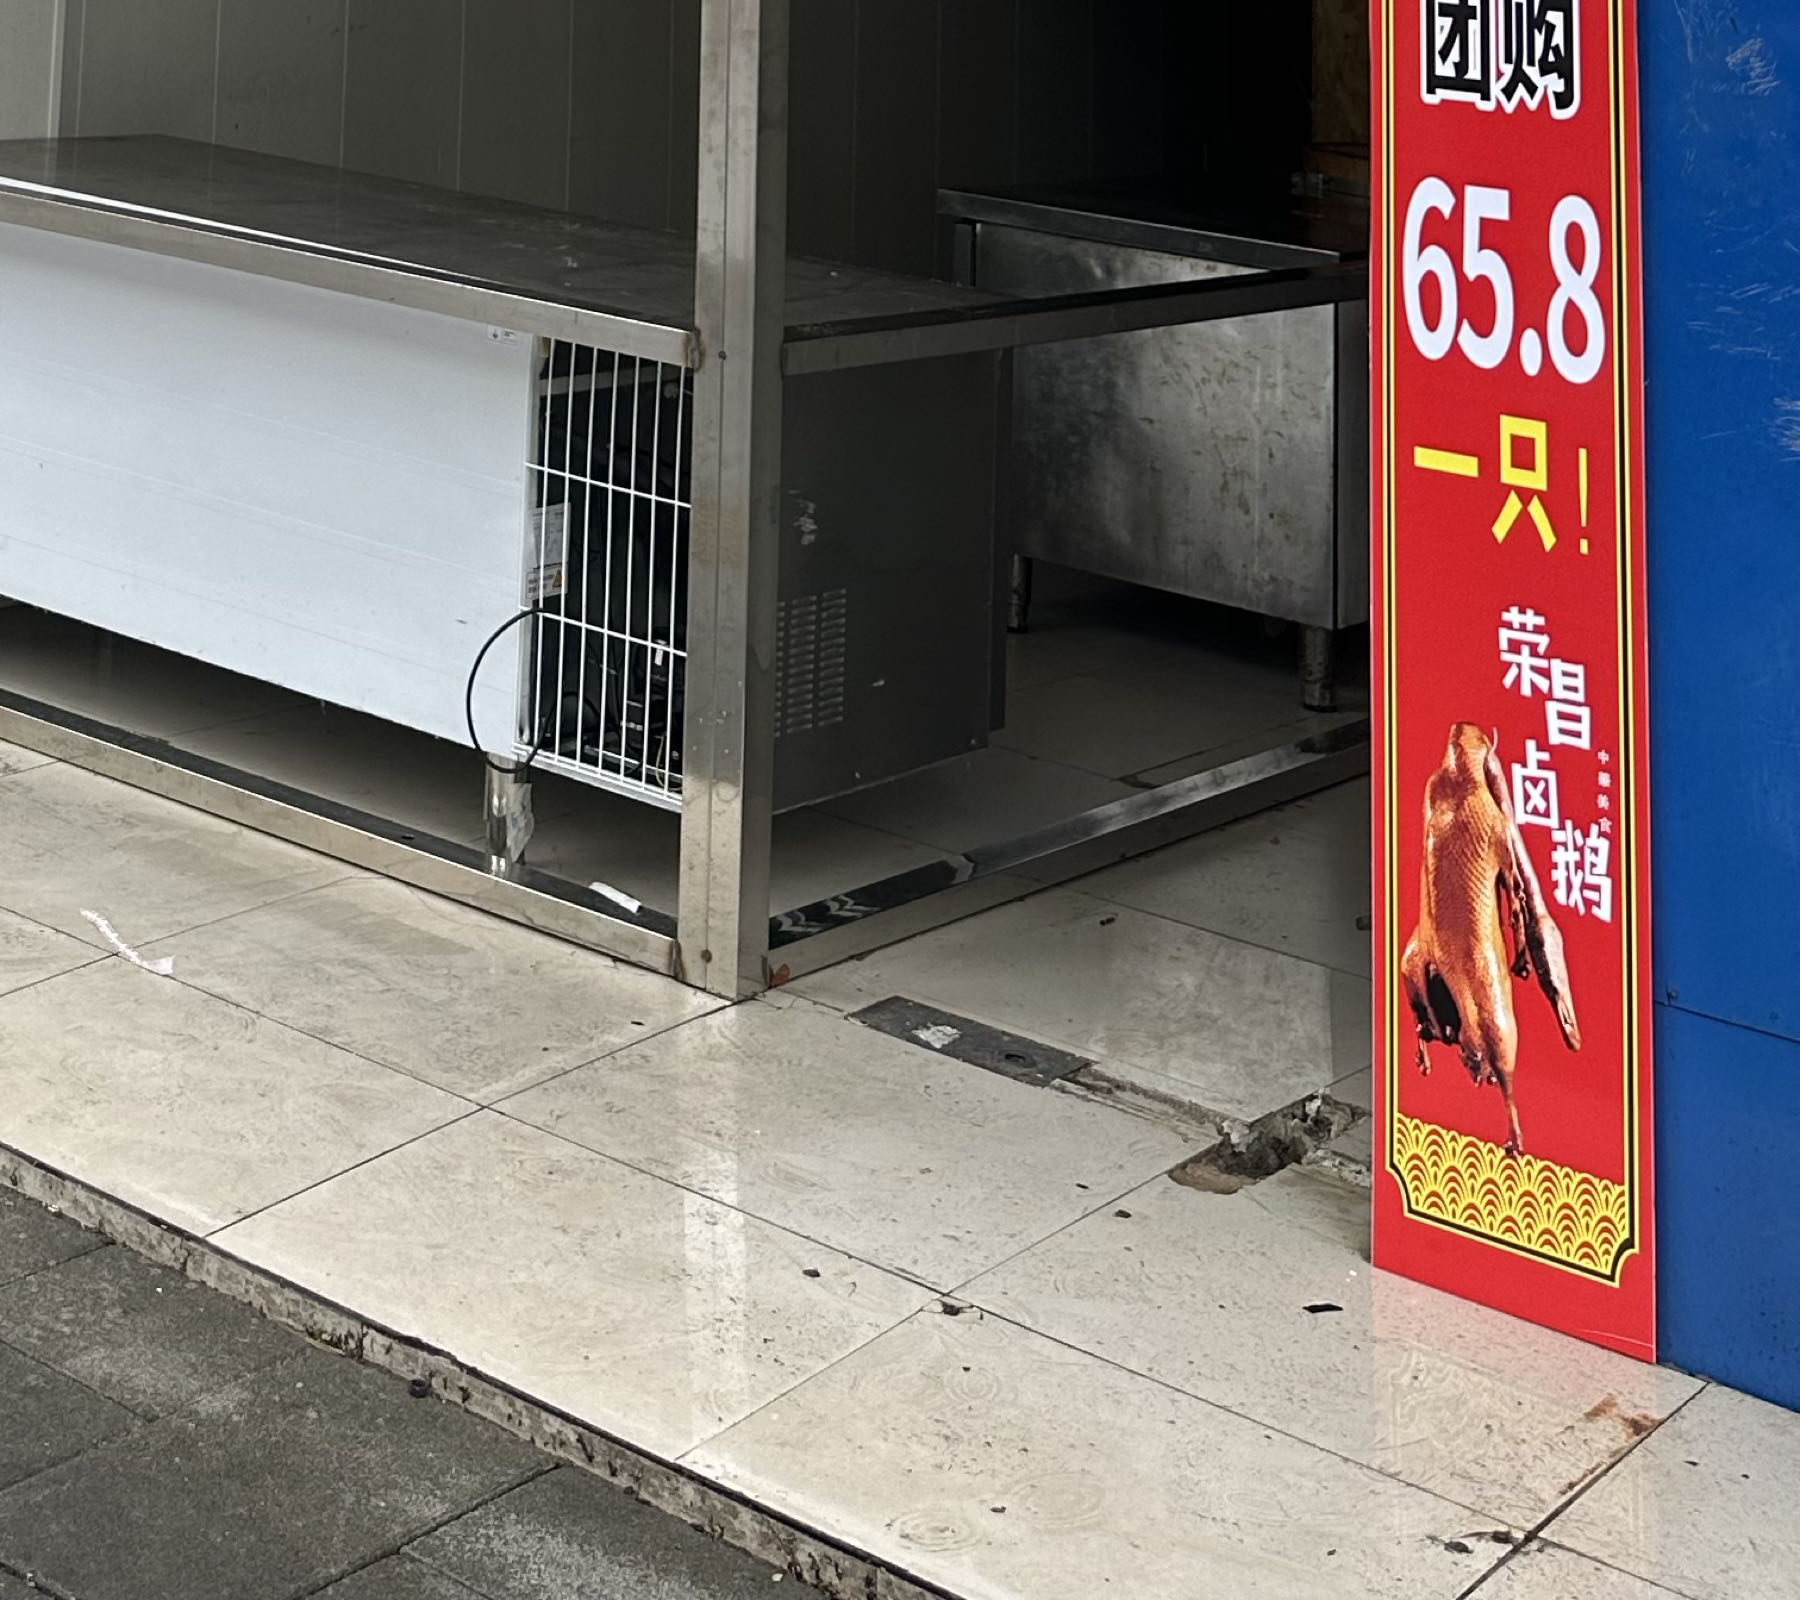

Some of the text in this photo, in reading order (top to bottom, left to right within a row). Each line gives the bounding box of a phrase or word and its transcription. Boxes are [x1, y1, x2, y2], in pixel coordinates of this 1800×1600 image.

[1402, 175, 1604, 385] 65.8
[1498, 605, 1612, 924] 荣昌卤鹅
